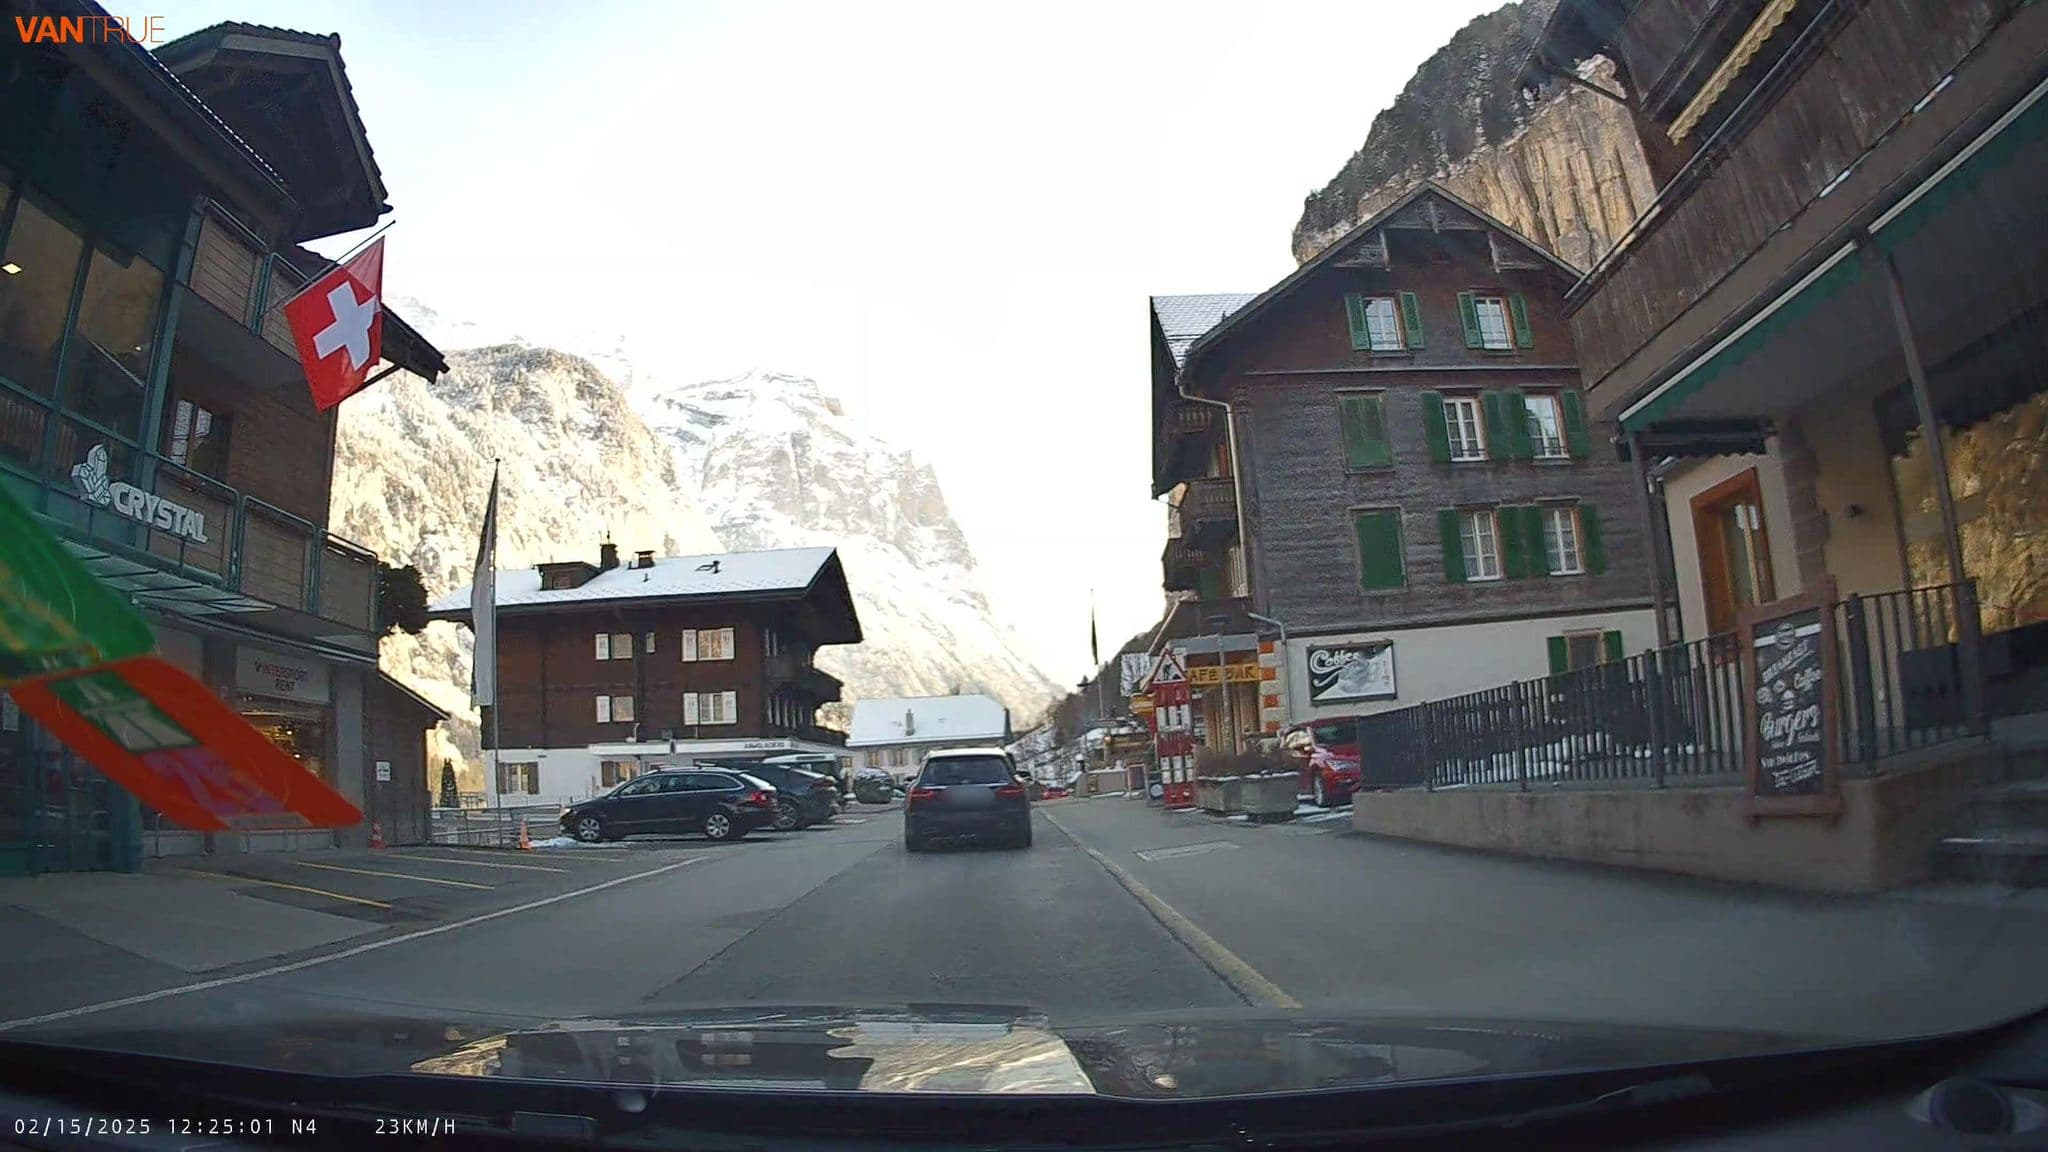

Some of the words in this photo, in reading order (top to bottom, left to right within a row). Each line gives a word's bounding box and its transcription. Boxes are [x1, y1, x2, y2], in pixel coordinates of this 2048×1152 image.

[109, 482, 208, 543] CRYSTAL
[1310, 649, 1361, 675] Coffee
[1794, 667, 1821, 692] Coffee
[1760, 704, 1819, 747] Burgers
